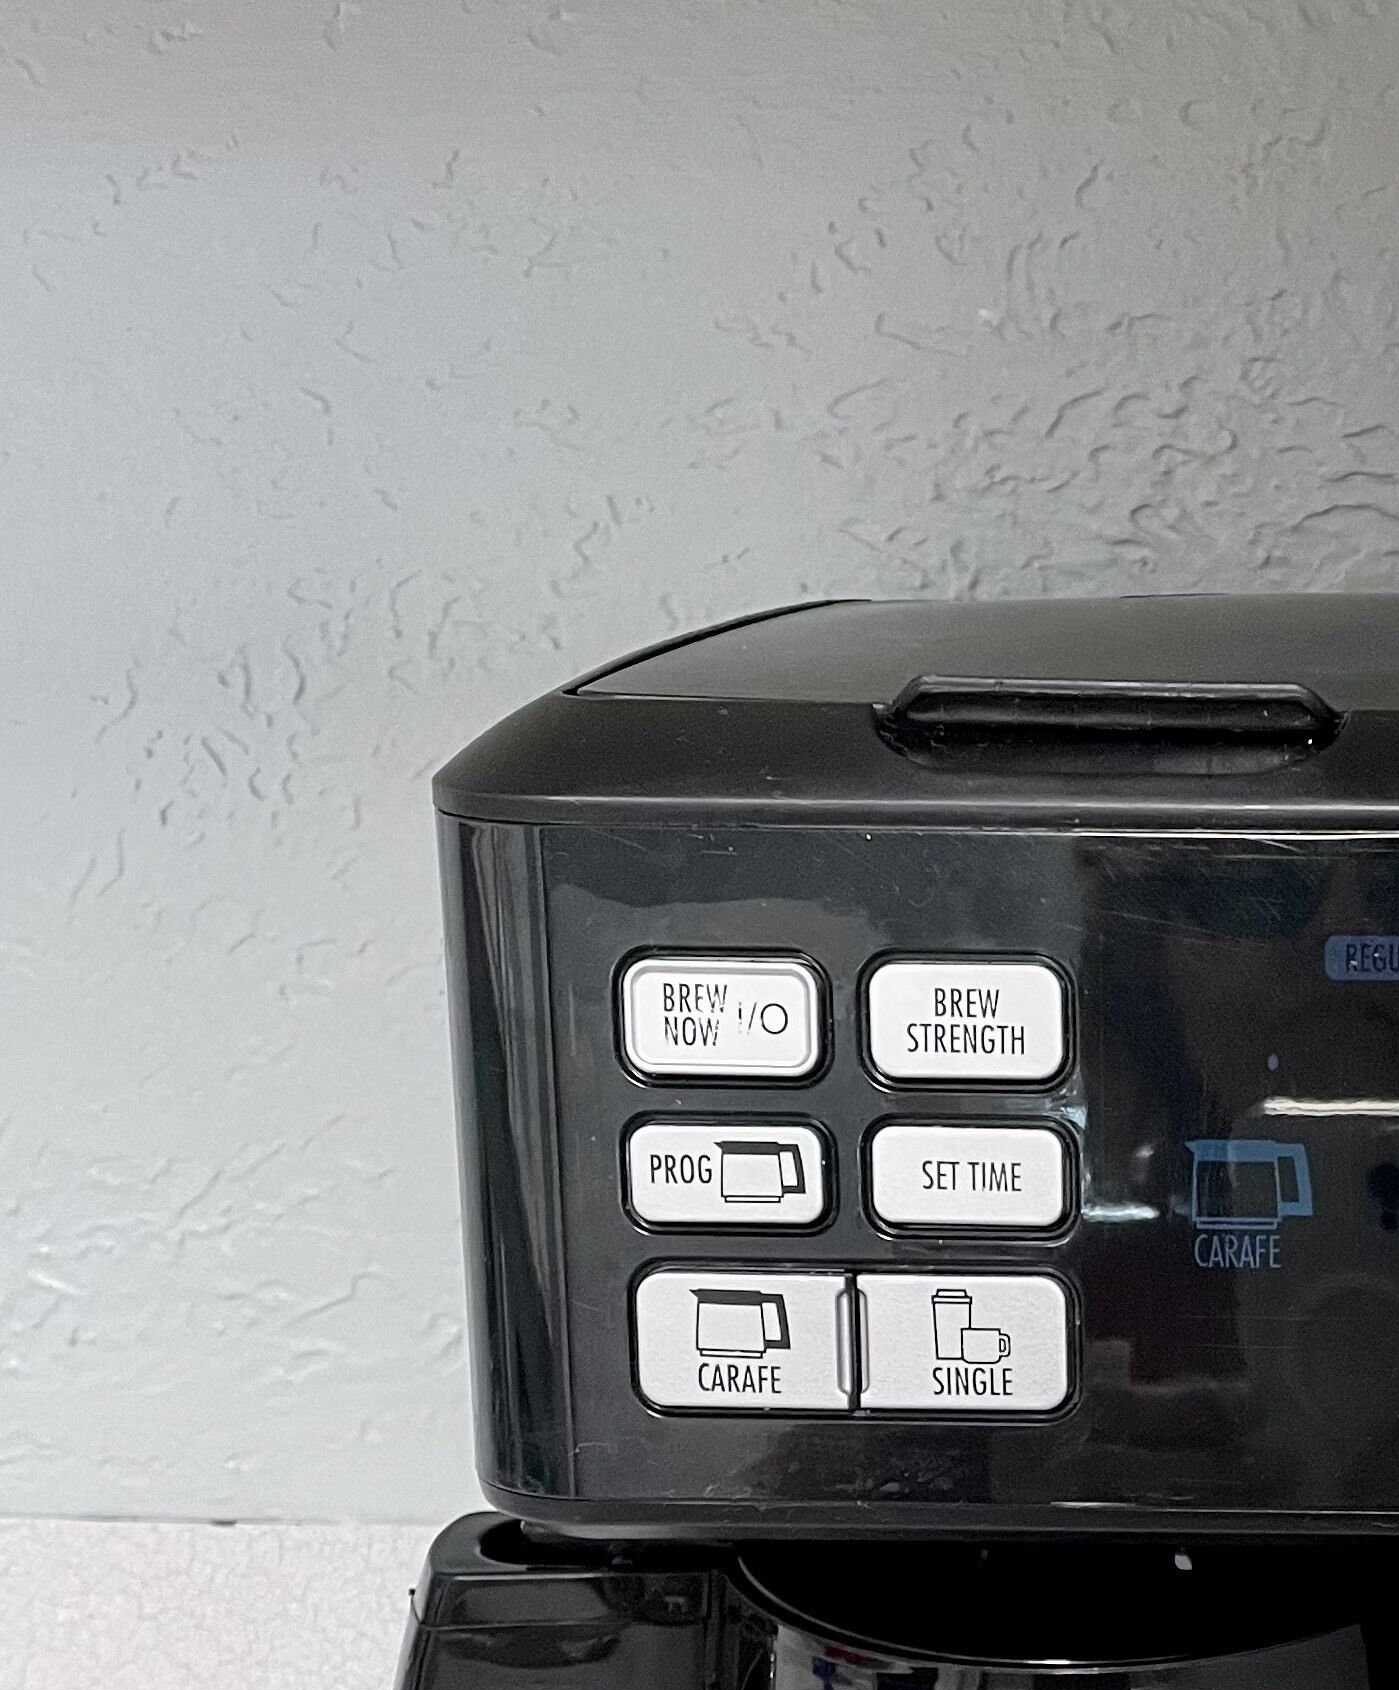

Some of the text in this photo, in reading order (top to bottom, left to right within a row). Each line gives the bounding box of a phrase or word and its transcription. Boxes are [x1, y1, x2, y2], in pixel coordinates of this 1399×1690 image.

[663, 982, 728, 1013] BREW
[934, 987, 1000, 1019] BREW
[664, 1015, 720, 1047] NOW
[907, 1022, 1025, 1056] STRENGTH
[650, 1153, 713, 1184] PROG
[922, 1160, 1022, 1192] SET TIME
[1194, 1234, 1282, 1269] CARAFE
[698, 1362, 782, 1394] CARAFE
[932, 1366, 1013, 1397] SINGLE
